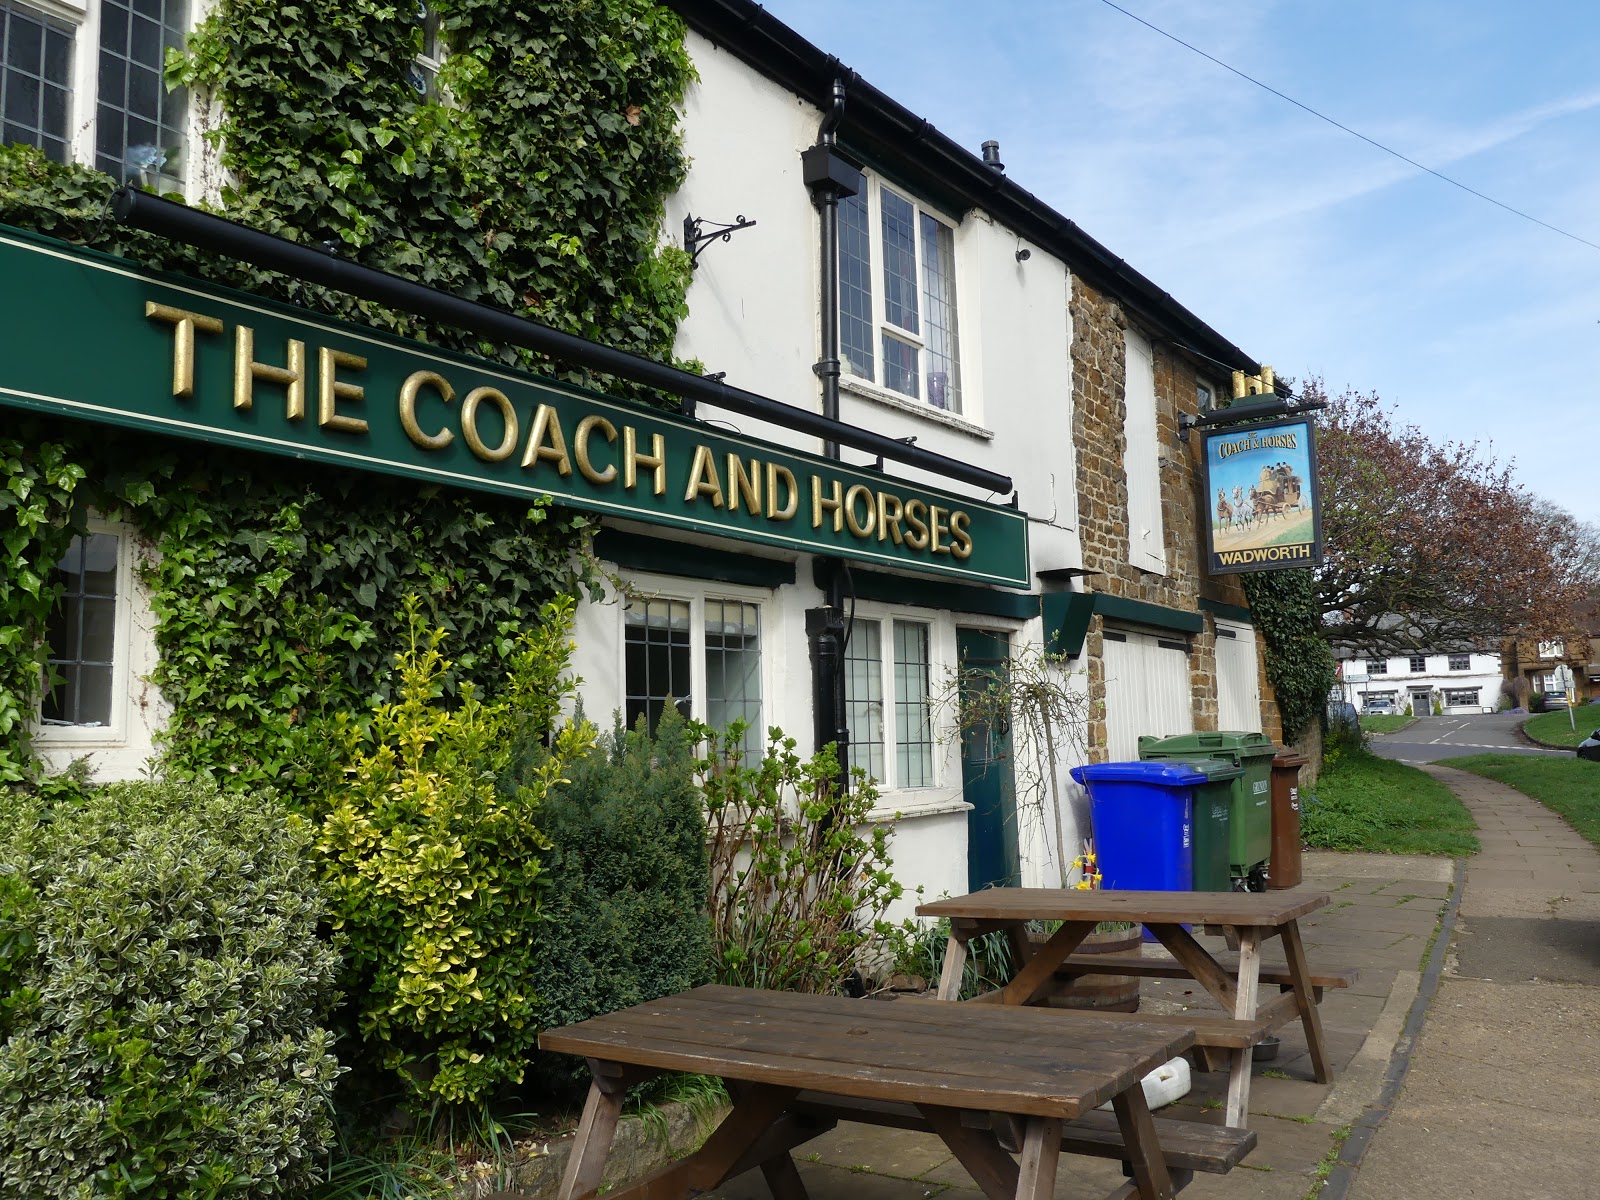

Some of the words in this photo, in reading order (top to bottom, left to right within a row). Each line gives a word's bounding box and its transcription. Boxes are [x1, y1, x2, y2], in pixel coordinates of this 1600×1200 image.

[145, 300, 369, 434] THE
[399, 369, 667, 496] COACH
[684, 444, 799, 521] AND
[811, 474, 974, 559] HORSES
[1218, 438, 1252, 459] COACH
[1252, 438, 1260, 449] &
[1261, 433, 1298, 449] HORSES
[1218, 545, 1310, 565] WADWORTH
